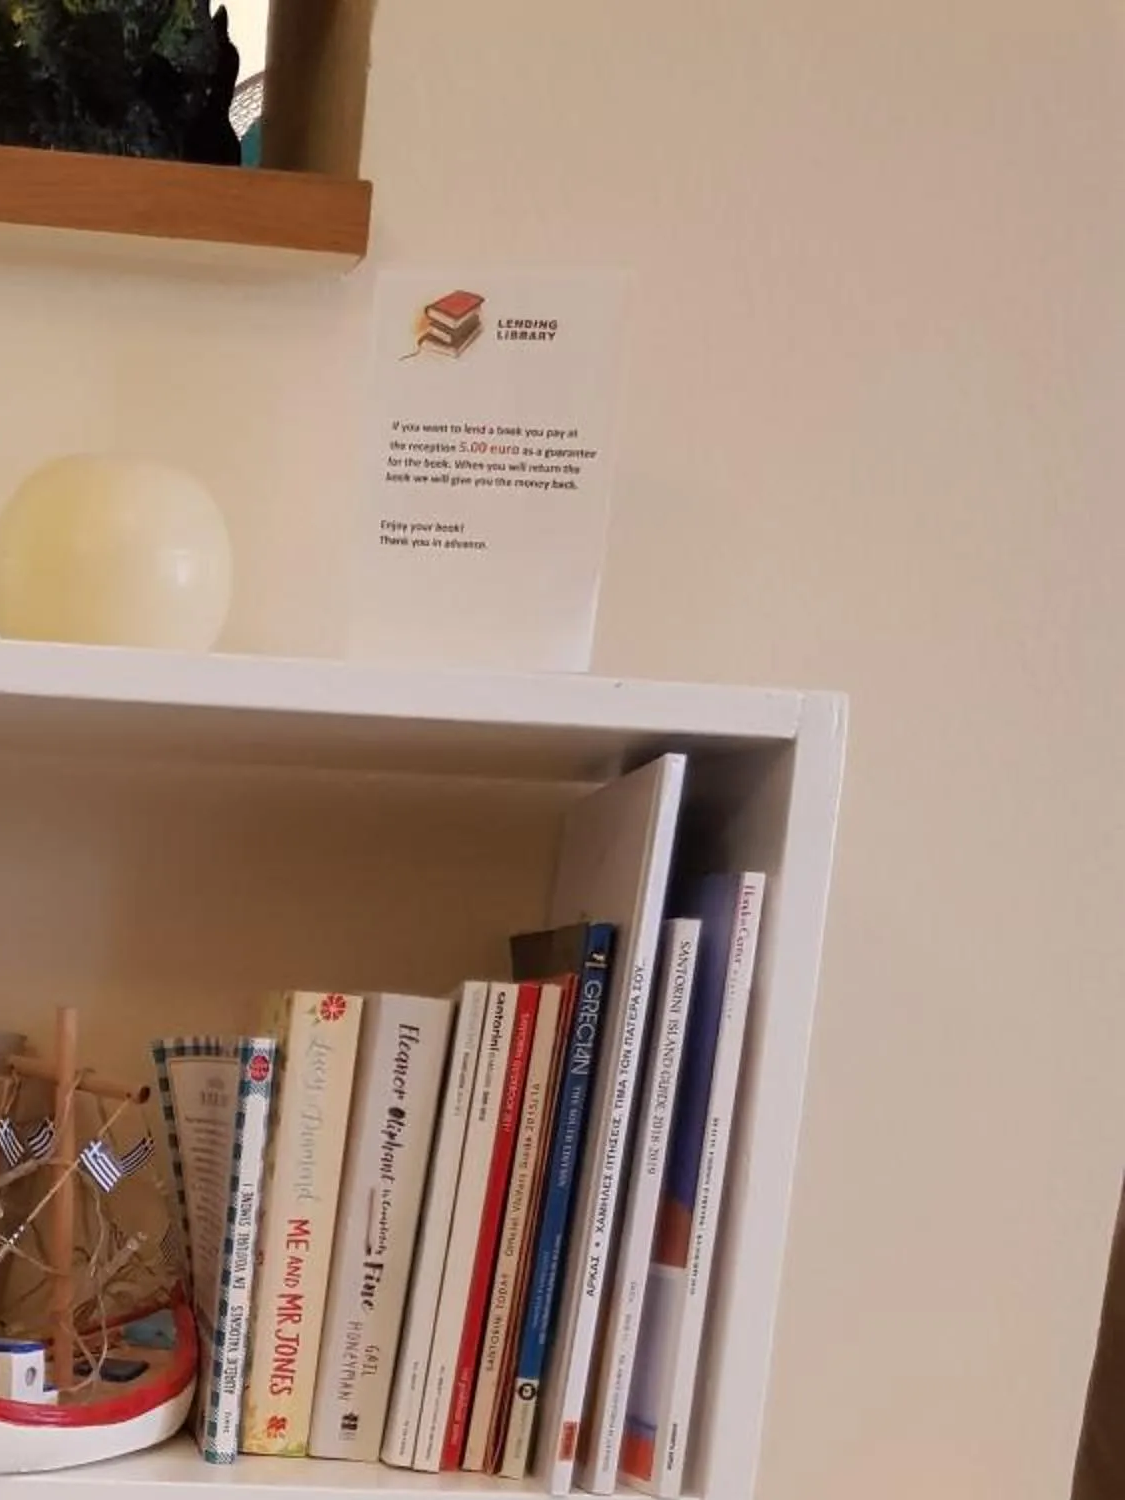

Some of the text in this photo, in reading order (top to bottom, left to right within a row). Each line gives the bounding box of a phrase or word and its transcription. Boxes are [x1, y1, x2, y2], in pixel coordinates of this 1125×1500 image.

[496, 330, 557, 341] LIBRARY
[497, 319, 558, 330] LENDING
[401, 423, 420, 434] you
[423, 423, 449, 433] want
[451, 424, 462, 433] to
[465, 423, 486, 435] lend
[497, 425, 522, 436] book
[525, 428, 544, 439] you
[546, 430, 565, 441] pay
[387, 456, 581, 474] for the book. When you will return the
[390, 441, 406, 451] the
[408, 442, 457, 455] reception
[459, 442, 488, 454] 5.00
[490, 445, 520, 456] euro
[544, 449, 597, 460] guarantee
[385, 471, 411, 482] book
[413, 475, 428, 483] we
[431, 473, 449, 483] will
[451, 475, 472, 486] give
[475, 478, 493, 488] you
[495, 477, 512, 487] the
[515, 478, 549, 490] money
[380, 520, 408, 532] Enjoy
[410, 523, 433, 533] your
[669, 940, 693, 1014] SANTORINI
[661, 1019, 683, 1070] ISLAND
[391, 1023, 421, 1101] Eleanor
[379, 1106, 407, 1185] Oliphant
[360, 1261, 385, 1313] Fine
[269, 1218, 311, 1397] ME AND MR JONES
[337, 1320, 364, 1401] HONEYMAN
[360, 1344, 379, 1378] GAIL
